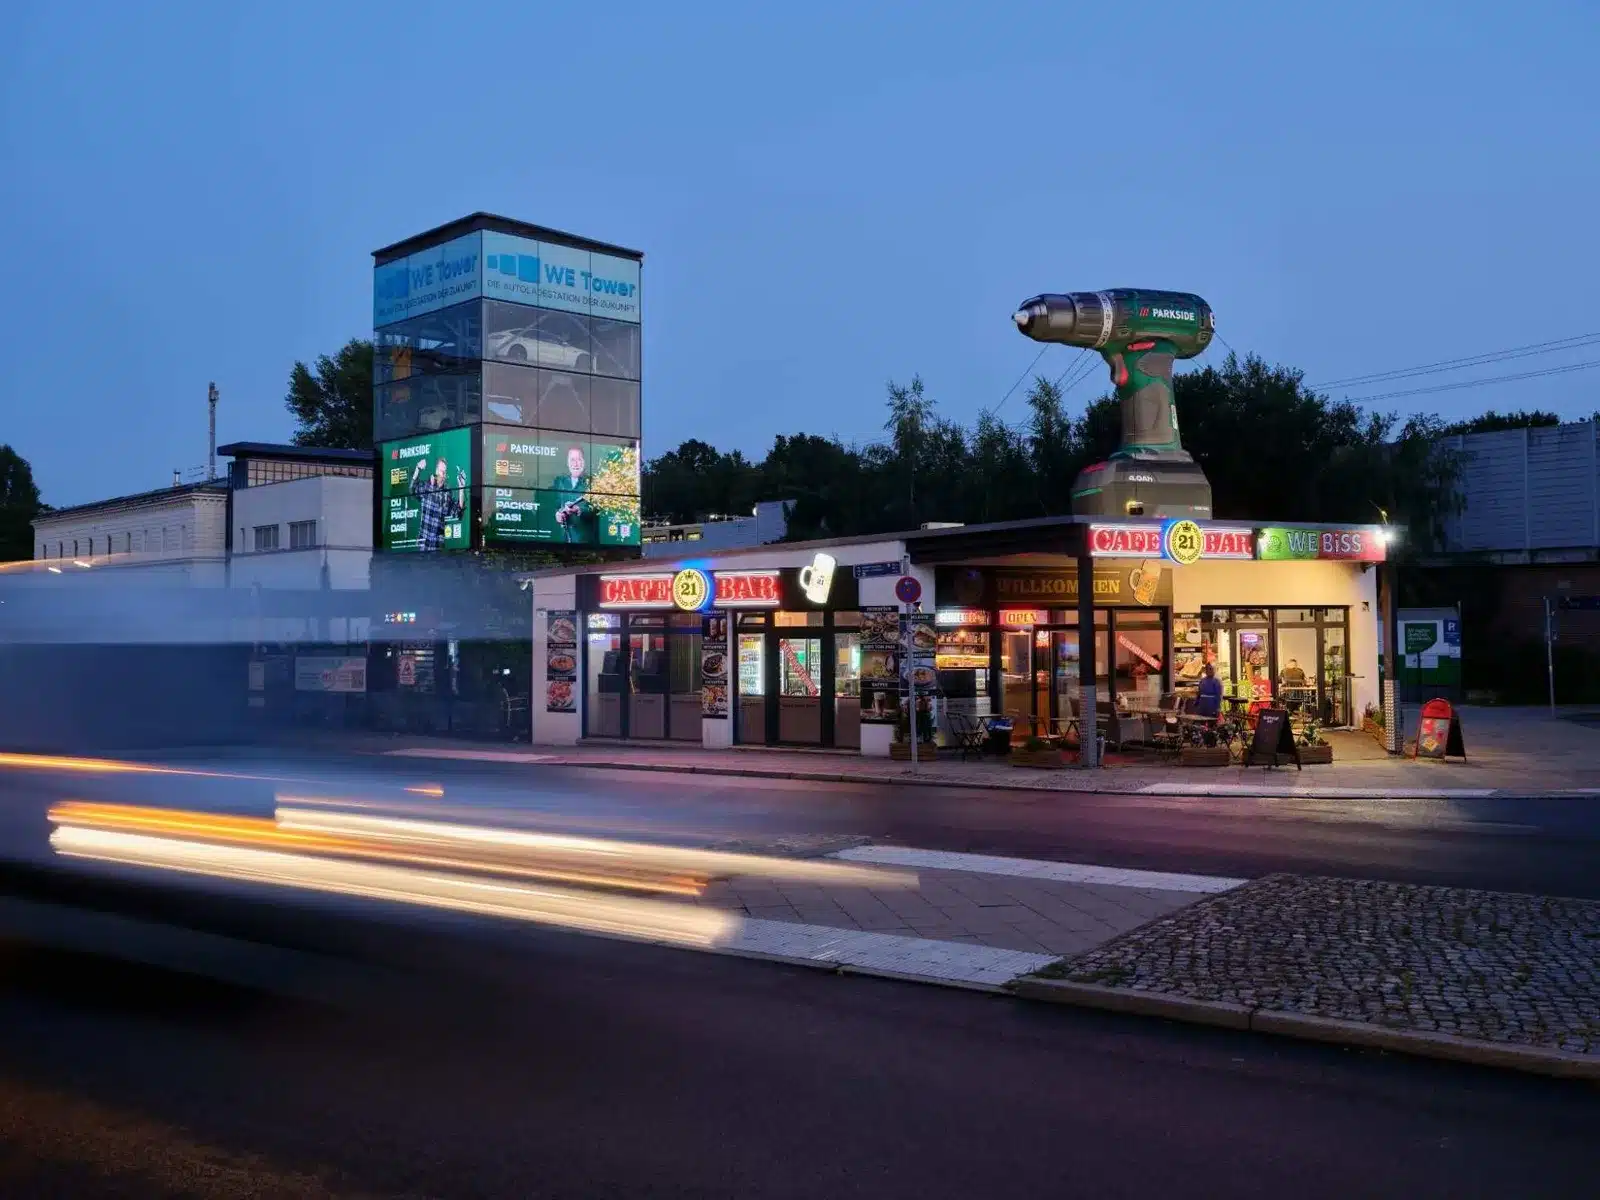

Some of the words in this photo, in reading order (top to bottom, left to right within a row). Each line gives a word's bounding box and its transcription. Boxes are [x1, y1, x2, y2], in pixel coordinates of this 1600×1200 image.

[409, 264, 434, 291] WE
[544, 263, 576, 288] WE
[580, 269, 636, 298] Tower
[487, 279, 501, 291] DIE
[503, 282, 581, 305] AUTOLADESTATION
[582, 296, 599, 308] DER
[600, 300, 636, 314] ZUKUNFT
[1152, 308, 1195, 321] PARKSIDE
[399, 444, 431, 460] PARKSIDE
[510, 443, 557, 457] PARKSIDE
[495, 488, 512, 498] DU
[390, 498, 402, 508] DU
[495, 500, 540, 511] PACKST
[1094, 528, 1160, 554] CAFE
[1178, 534, 1196, 550] 21
[1203, 532, 1252, 554] BAR
[1287, 532, 1318, 552] WE
[1321, 532, 1361, 553] BiSS
[606, 579, 672, 603] CAFE
[680, 582, 698, 597] 21
[717, 575, 777, 600] BAR
[1007, 612, 1038, 625] OPEN
